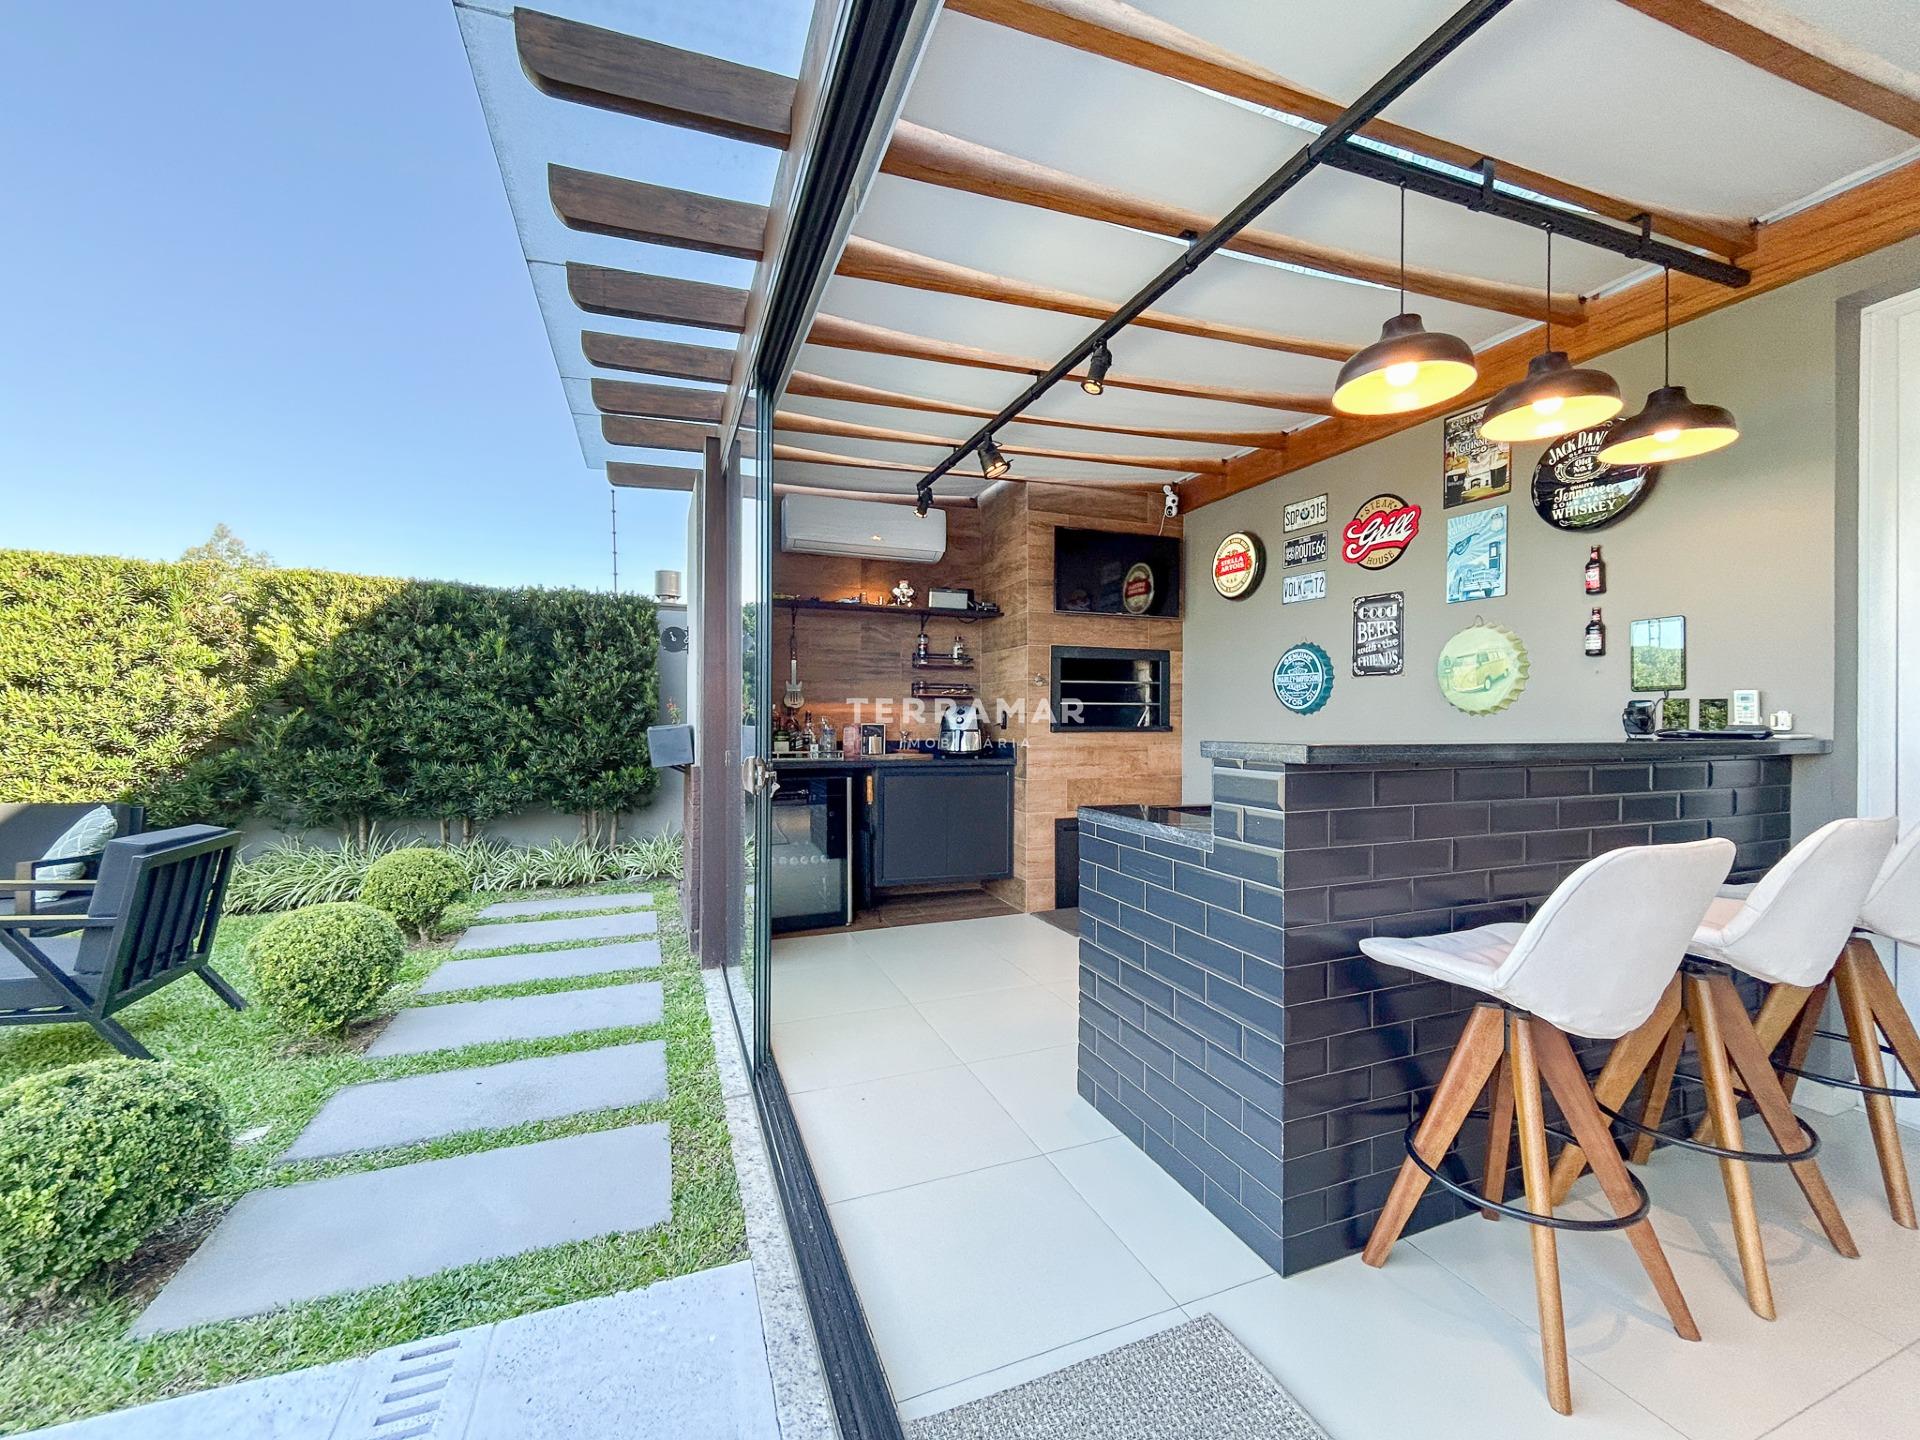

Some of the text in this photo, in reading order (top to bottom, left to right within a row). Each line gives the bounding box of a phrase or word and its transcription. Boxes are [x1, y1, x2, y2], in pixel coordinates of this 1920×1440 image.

[1549, 439, 1576, 465] JACK
[1568, 445, 1600, 459] OLD TIME
[1574, 456, 1592, 467] Old
[1554, 483, 1614, 503] Tennessee
[1570, 481, 1595, 490] QUALITY
[1285, 501, 1326, 527] SDP 315
[1364, 499, 1396, 514] STEAK
[1551, 498, 1617, 520] WHISKEY
[1346, 510, 1416, 559] Grill
[1221, 556, 1244, 566] STELLA
[1366, 549, 1395, 565] HOUSE
[1221, 563, 1245, 573] ARTOIS
[1315, 577, 1325, 593] T2
[1357, 620, 1399, 644] BEER
[1381, 638, 1399, 649] the
[1283, 652, 1313, 665] GENUINE
[1357, 649, 1399, 667] FRIENDS
[1280, 689, 1303, 706] MOTOR
[1306, 689, 1317, 702] OIL
